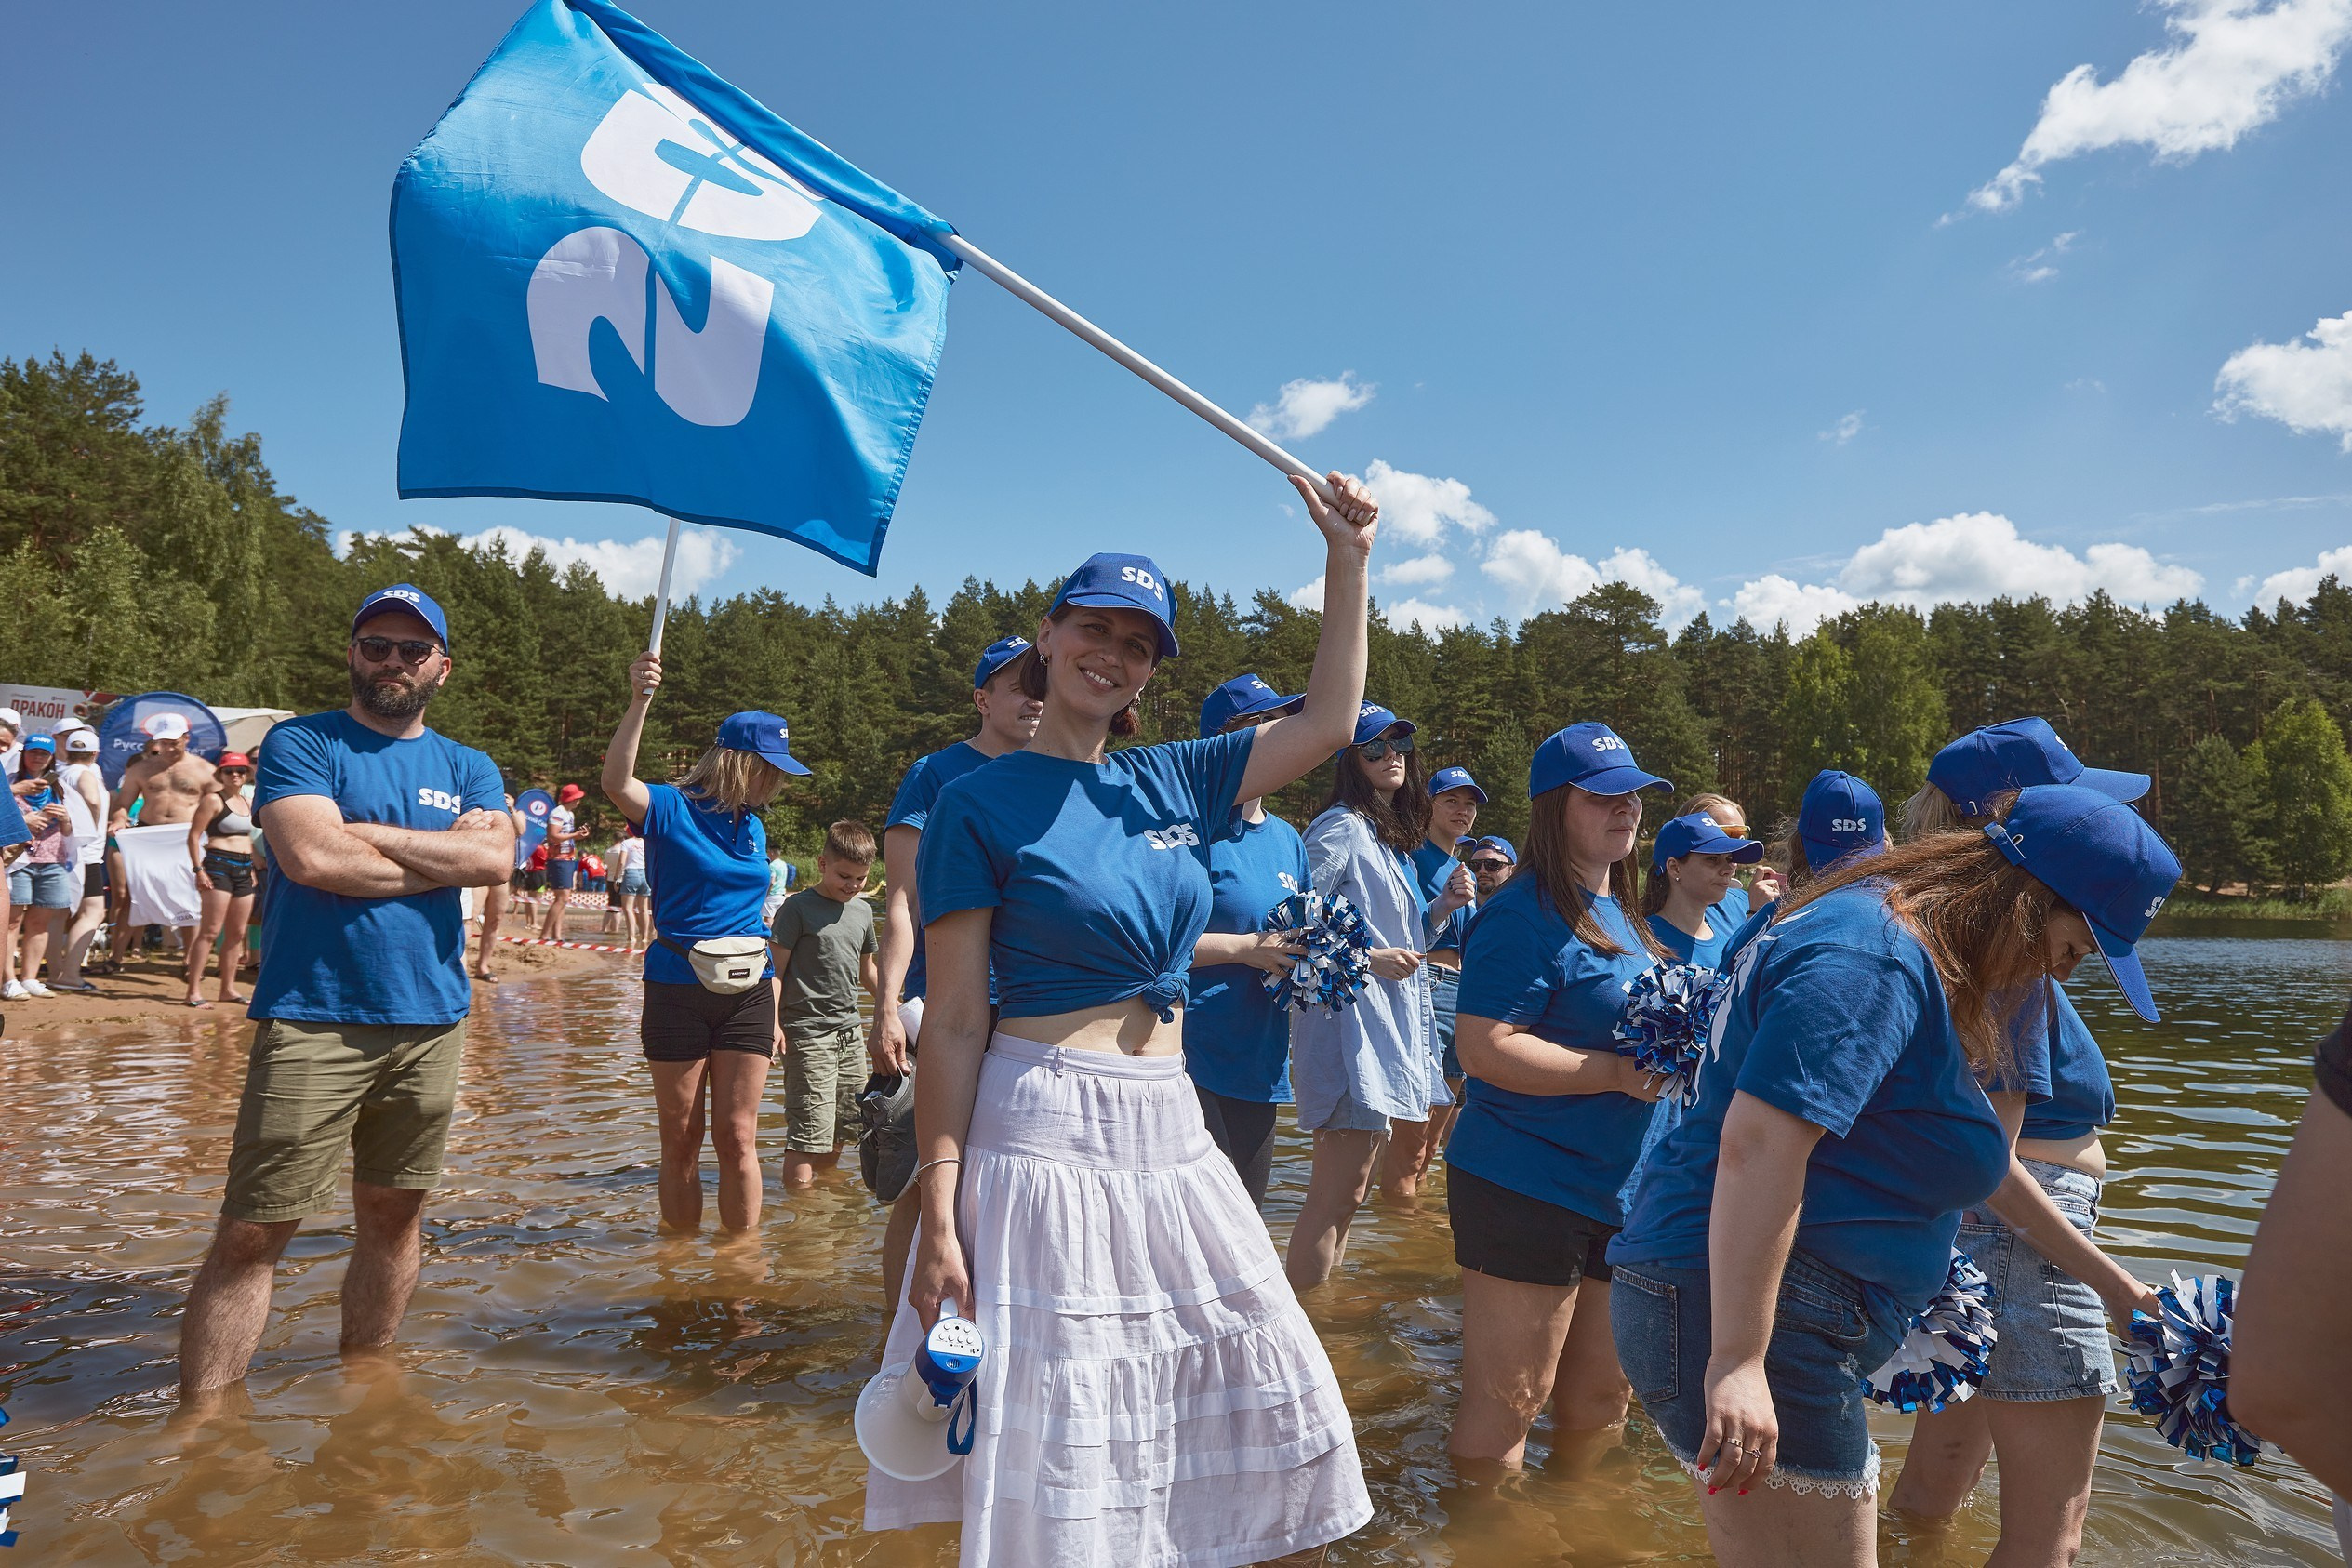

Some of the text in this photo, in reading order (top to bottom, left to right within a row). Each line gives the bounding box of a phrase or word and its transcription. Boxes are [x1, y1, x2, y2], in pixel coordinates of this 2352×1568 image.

[1122, 566, 1163, 602] SDS
[113, 738, 145, 752] Русс
[1831, 817, 1867, 832] SDS
[1143, 823, 1200, 850] SDS
